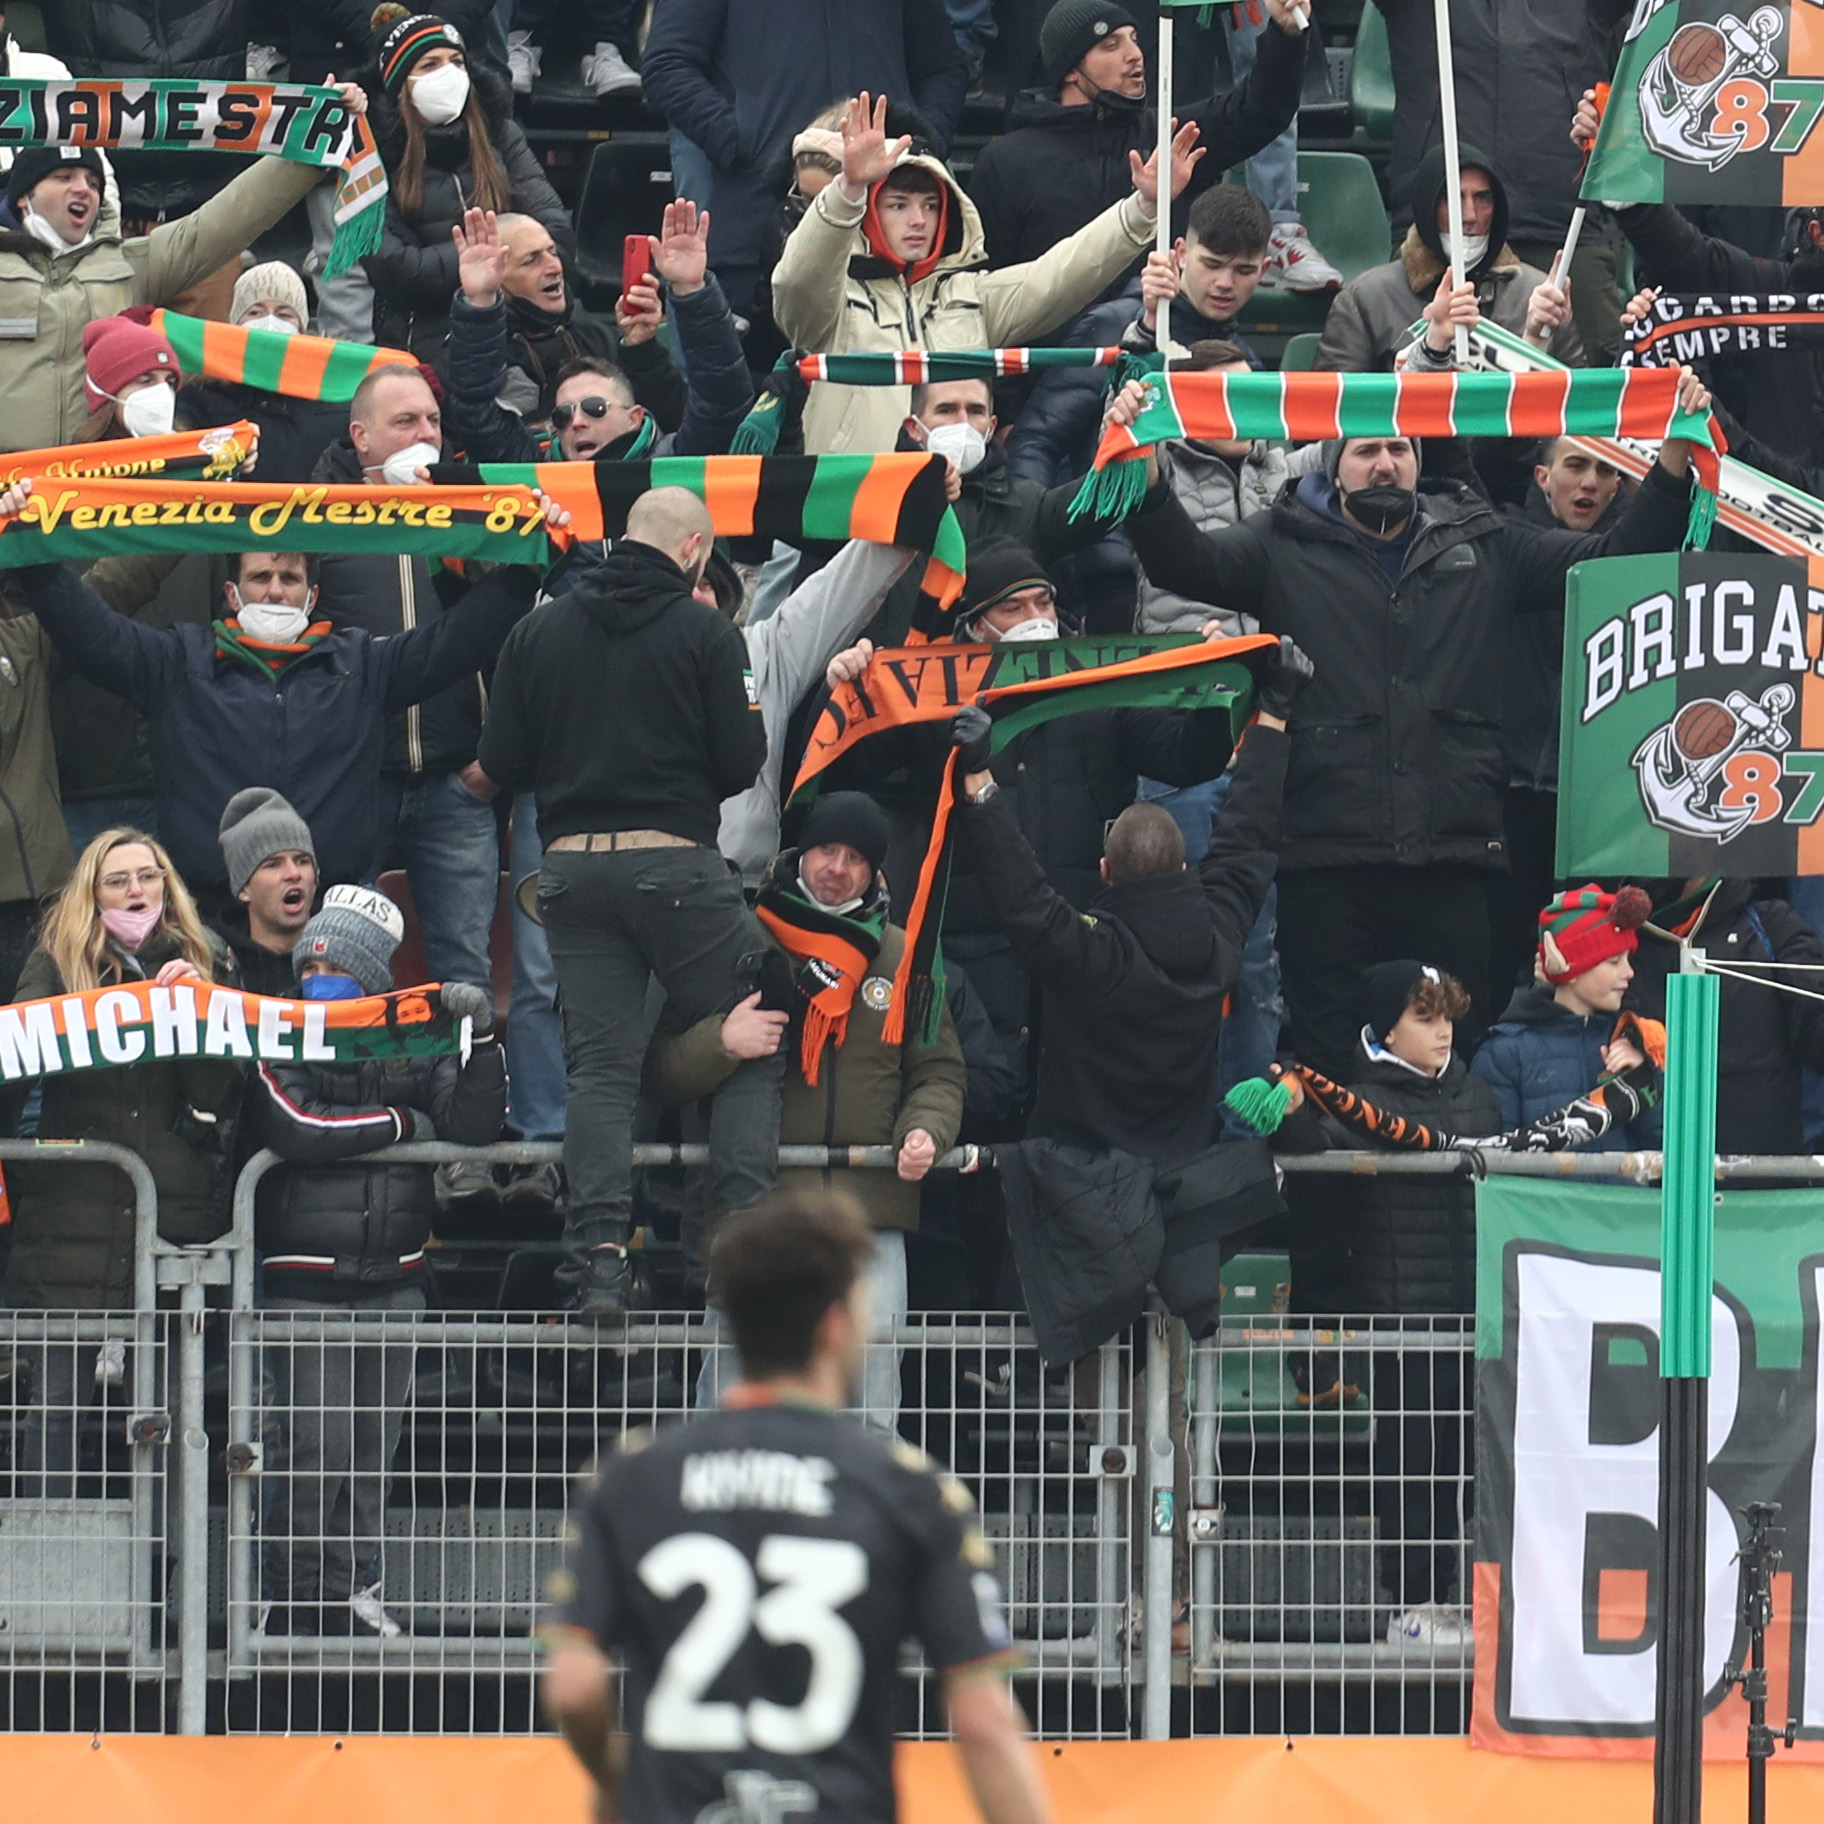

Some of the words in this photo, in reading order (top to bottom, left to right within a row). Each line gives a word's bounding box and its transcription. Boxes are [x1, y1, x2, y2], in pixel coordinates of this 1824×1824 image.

[0, 88, 372, 162] ZIAMESTR
[20, 490, 236, 534] Venezia
[248, 485, 452, 535] Mestre
[326, 884, 393, 924] ALLAS
[0, 985, 338, 1079] MICHAEL
[637, 1535, 873, 1755] 23
